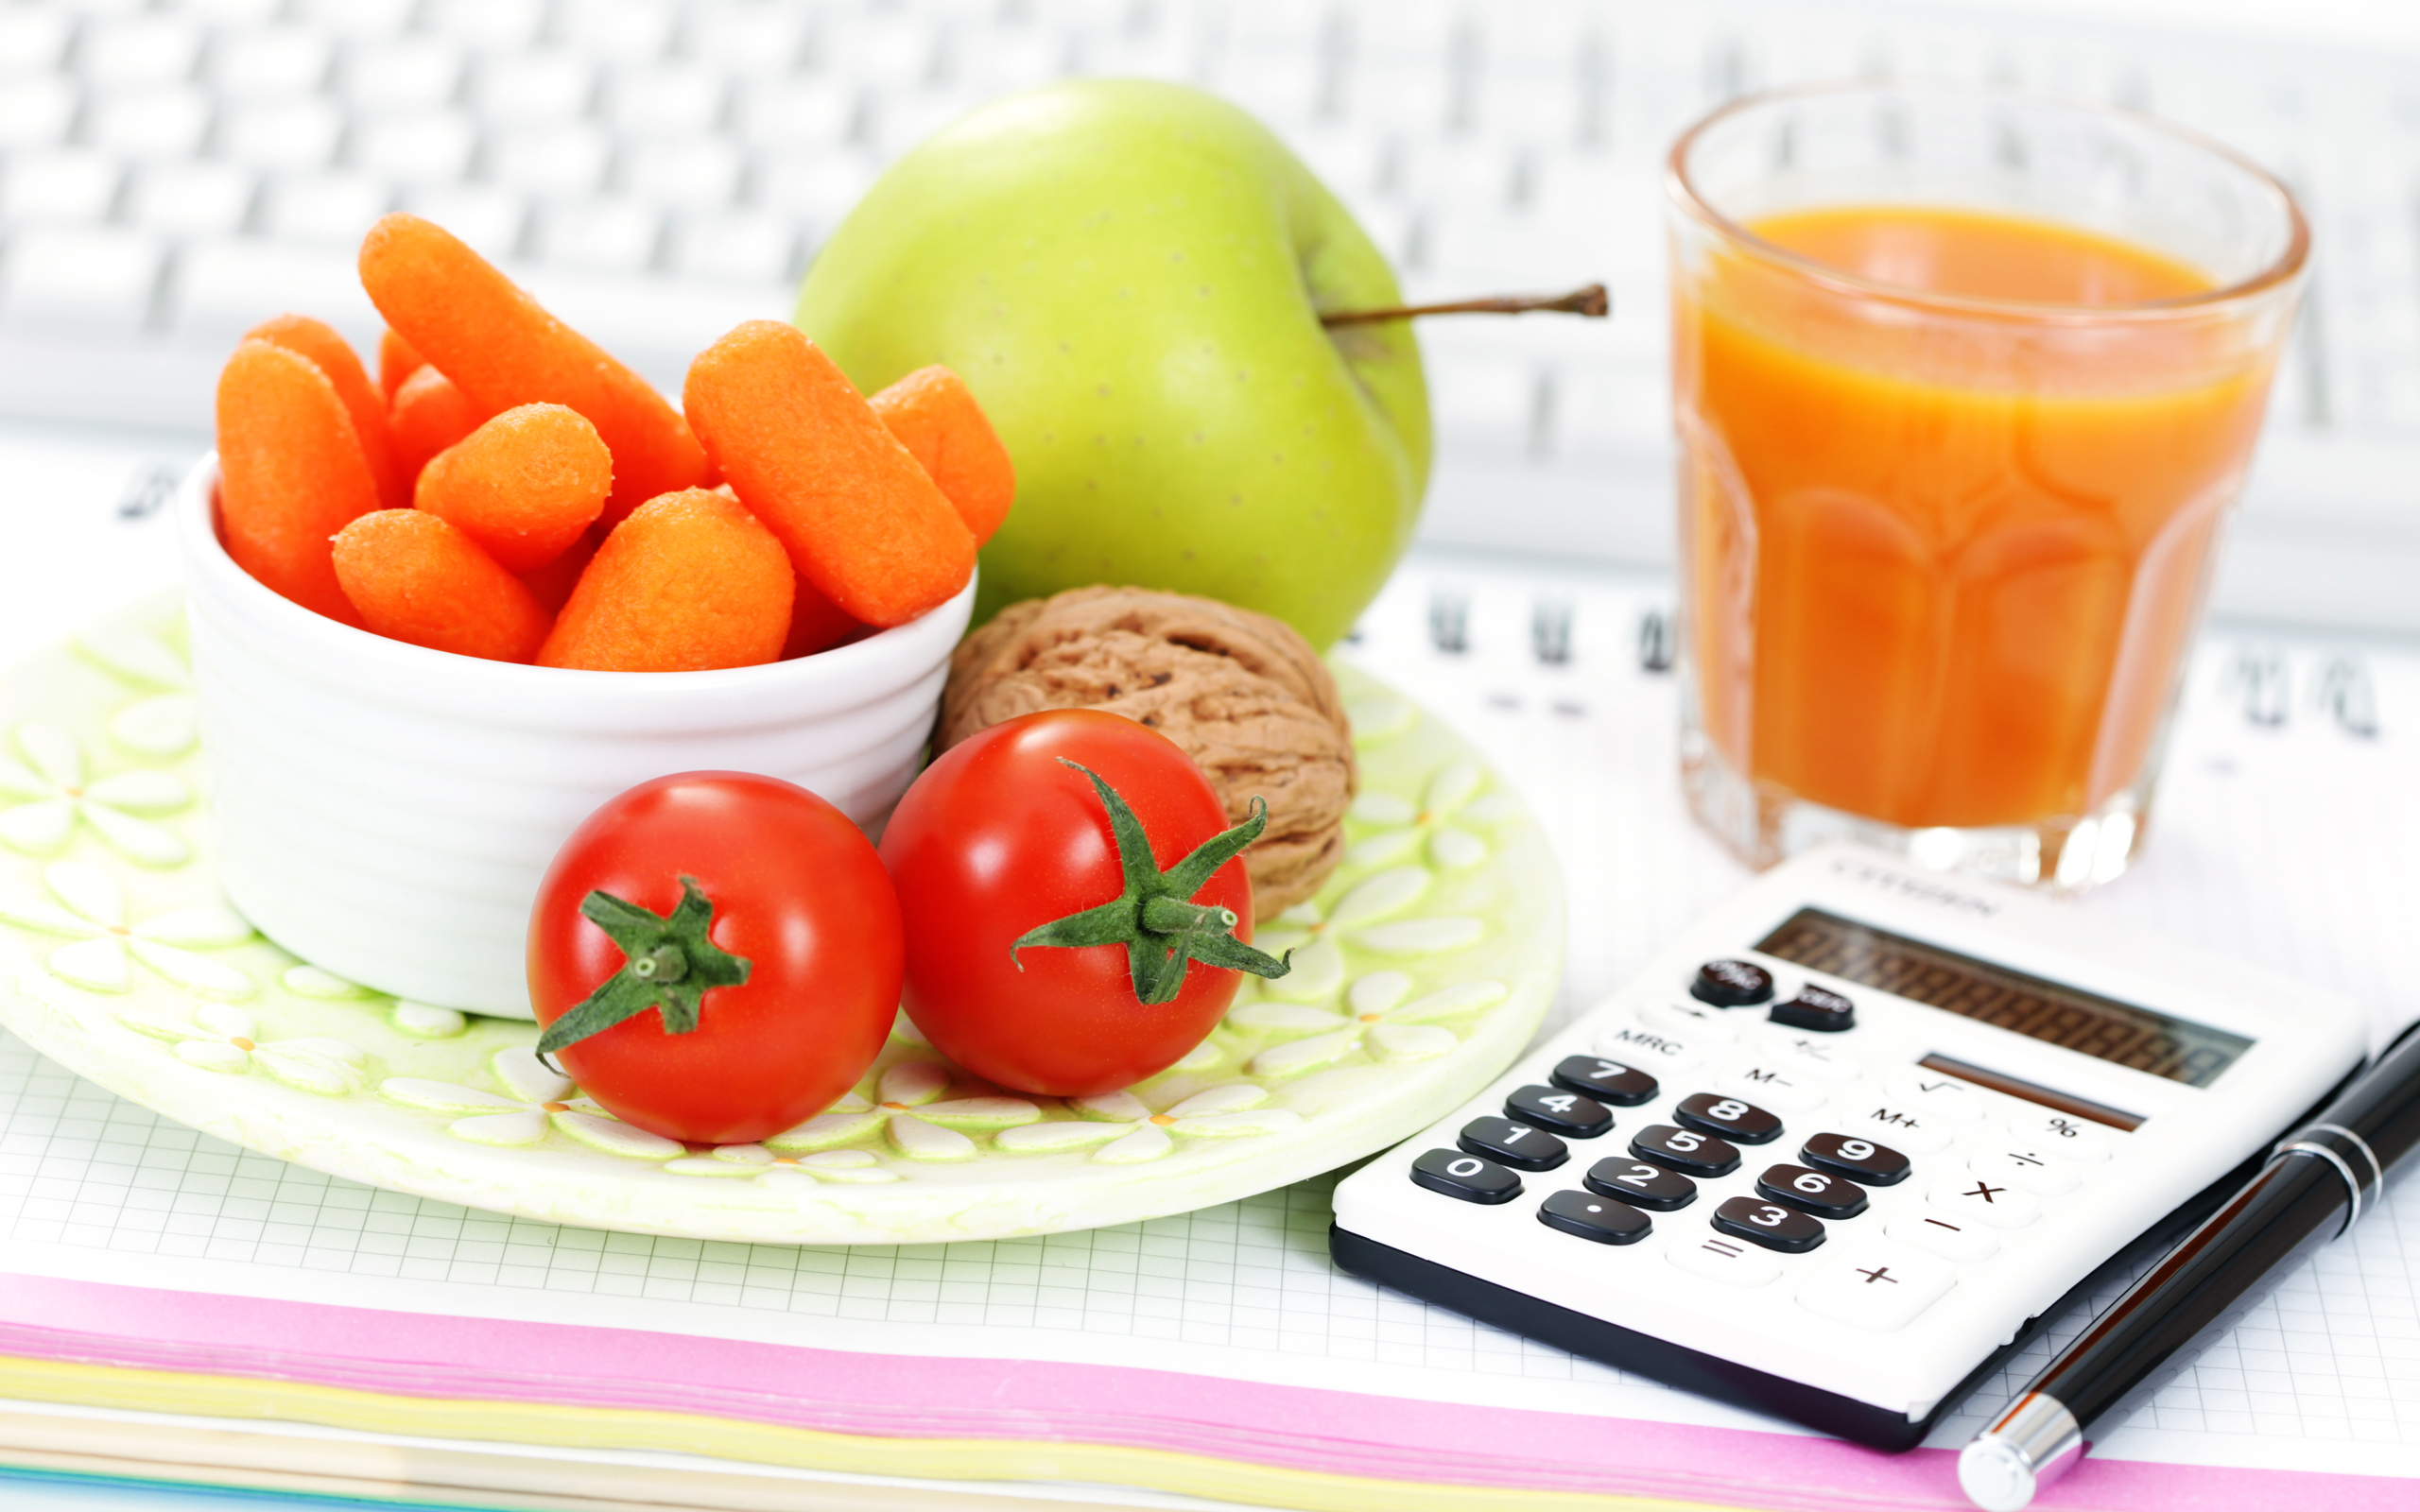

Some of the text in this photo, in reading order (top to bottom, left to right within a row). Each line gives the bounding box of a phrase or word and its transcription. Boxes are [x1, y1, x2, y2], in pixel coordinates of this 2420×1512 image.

[1615, 1029, 1684, 1056] MRC
[1589, 1060, 1627, 1079] 7
[1538, 1094, 1579, 1112] 4
[1707, 1099, 1749, 1121] 8
[1871, 1108, 1920, 1129] M+
[2046, 1118, 2081, 1138] %
[1503, 1126, 1532, 1144] 1
[1666, 1130, 1706, 1152] 5
[1837, 1140, 1876, 1160] 9
[1446, 1158, 1483, 1177] 0
[1616, 1165, 1659, 1187] 2
[1793, 1173, 1832, 1194] 6
[1749, 1206, 1789, 1227] 3
